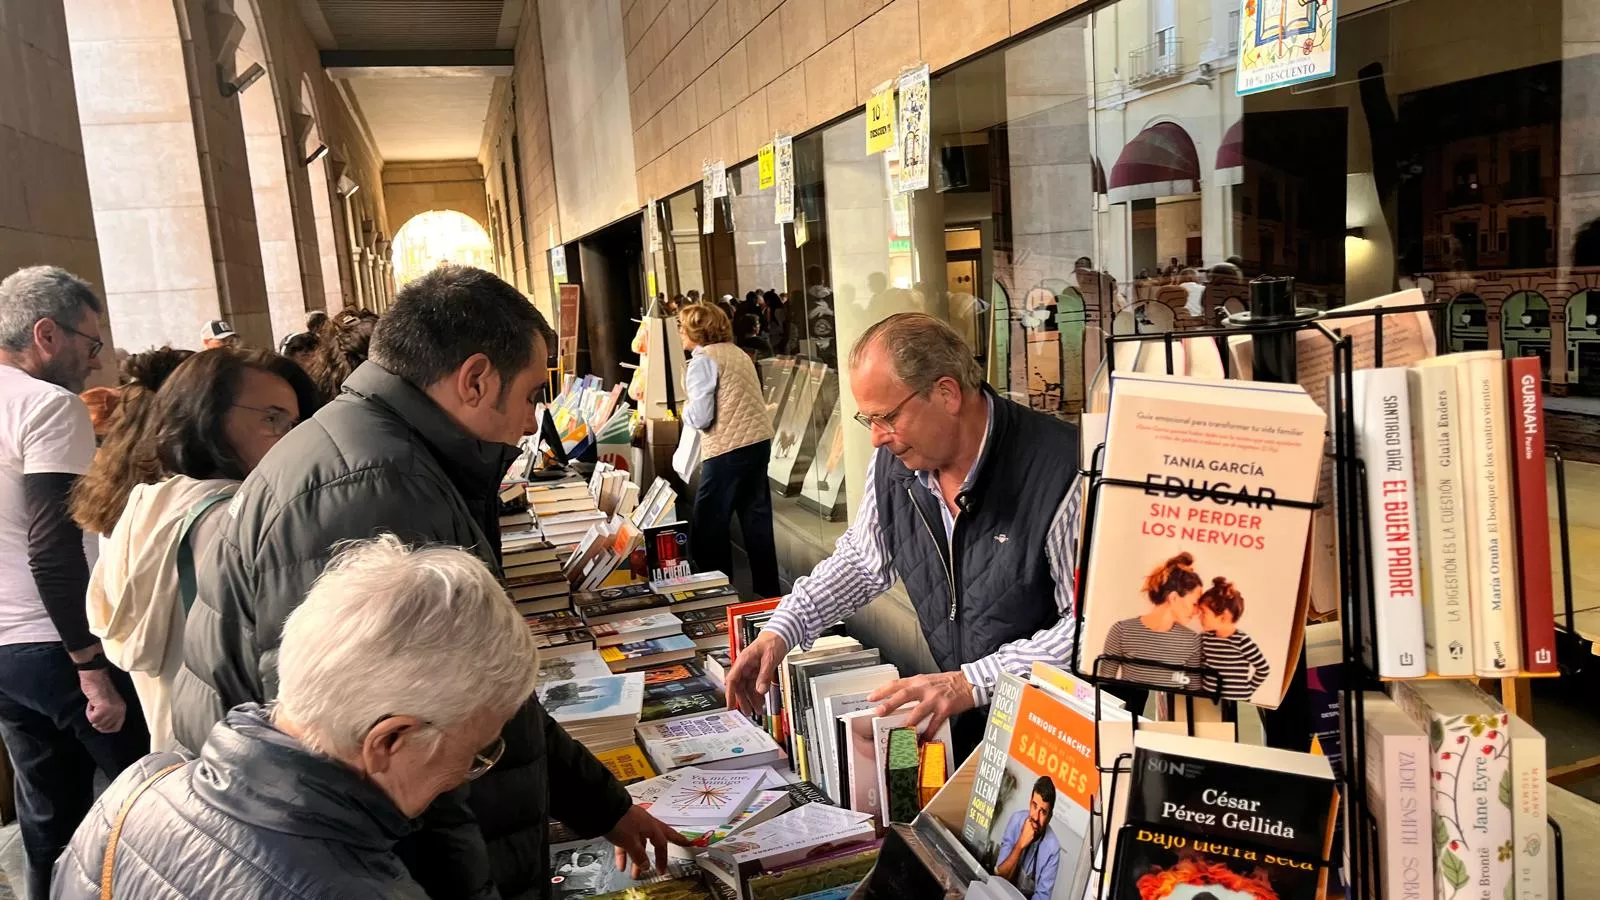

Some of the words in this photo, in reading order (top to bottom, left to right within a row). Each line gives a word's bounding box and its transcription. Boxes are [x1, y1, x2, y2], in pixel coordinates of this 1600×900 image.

[1264, 63, 1316, 83] DESCUENTO
[872, 104, 880, 122] 10
[1439, 390, 1449, 427] Enders
[1483, 379, 1492, 416] vientos
[1521, 374, 1537, 435] GURNAH
[1155, 415, 1190, 425] emocional
[1191, 419, 1207, 427] para
[1208, 420, 1250, 431] transformar
[1261, 425, 1276, 434] vida
[1277, 426, 1305, 436] familiar
[1383, 395, 1400, 447] SANTIAGO
[1485, 418, 1494, 450] cuatro
[1163, 454, 1206, 471] TANIA
[1208, 460, 1265, 477] GARCÍA
[1386, 449, 1403, 473] DÍAZ
[1438, 431, 1450, 467] Giulia
[1486, 452, 1495, 467] los
[1383, 480, 1407, 496] EL
[1487, 469, 1496, 481] de
[1144, 474, 1276, 511] EDUCAR
[1440, 478, 1455, 523] CUESTIÓN
[1487, 485, 1499, 520] bosque
[1150, 503, 1180, 520] SIN
[1187, 508, 1262, 529] PERDER
[1384, 502, 1410, 542] BUEN
[1488, 522, 1499, 533] El
[1141, 521, 1176, 538] LOS
[1181, 528, 1265, 550] NERVIOS
[1443, 527, 1456, 539] LA
[1445, 542, 1457, 554] ES
[1490, 538, 1501, 573] Oruña
[1387, 547, 1414, 598] PADRE
[1445, 557, 1459, 606] DIGESTIÓN
[1492, 577, 1502, 610] María
[1448, 609, 1460, 622] LA
[996, 696, 1013, 716] ROCA
[998, 681, 1019, 700] JORDI
[987, 725, 997, 743] LA
[1028, 711, 1057, 734] ENRIQUE
[1057, 730, 1091, 758] SÁNCHEZ
[983, 743, 1008, 768] NEVER
[1019, 734, 1088, 794] SABORES
[1399, 752, 1416, 792] ZADIE
[1472, 756, 1491, 793] Eyre
[868, 788, 877, 808] 9
[975, 779, 998, 804] LLENA
[1202, 788, 1261, 812] César
[1522, 772, 1530, 814] SIGMAN
[1531, 768, 1540, 818] MARIANO
[1161, 801, 1216, 826] Pérez
[1222, 812, 1295, 839] Gellida
[1400, 797, 1418, 845] SMITH
[1472, 797, 1488, 833] Jane
[1477, 847, 1490, 886] Brontë
